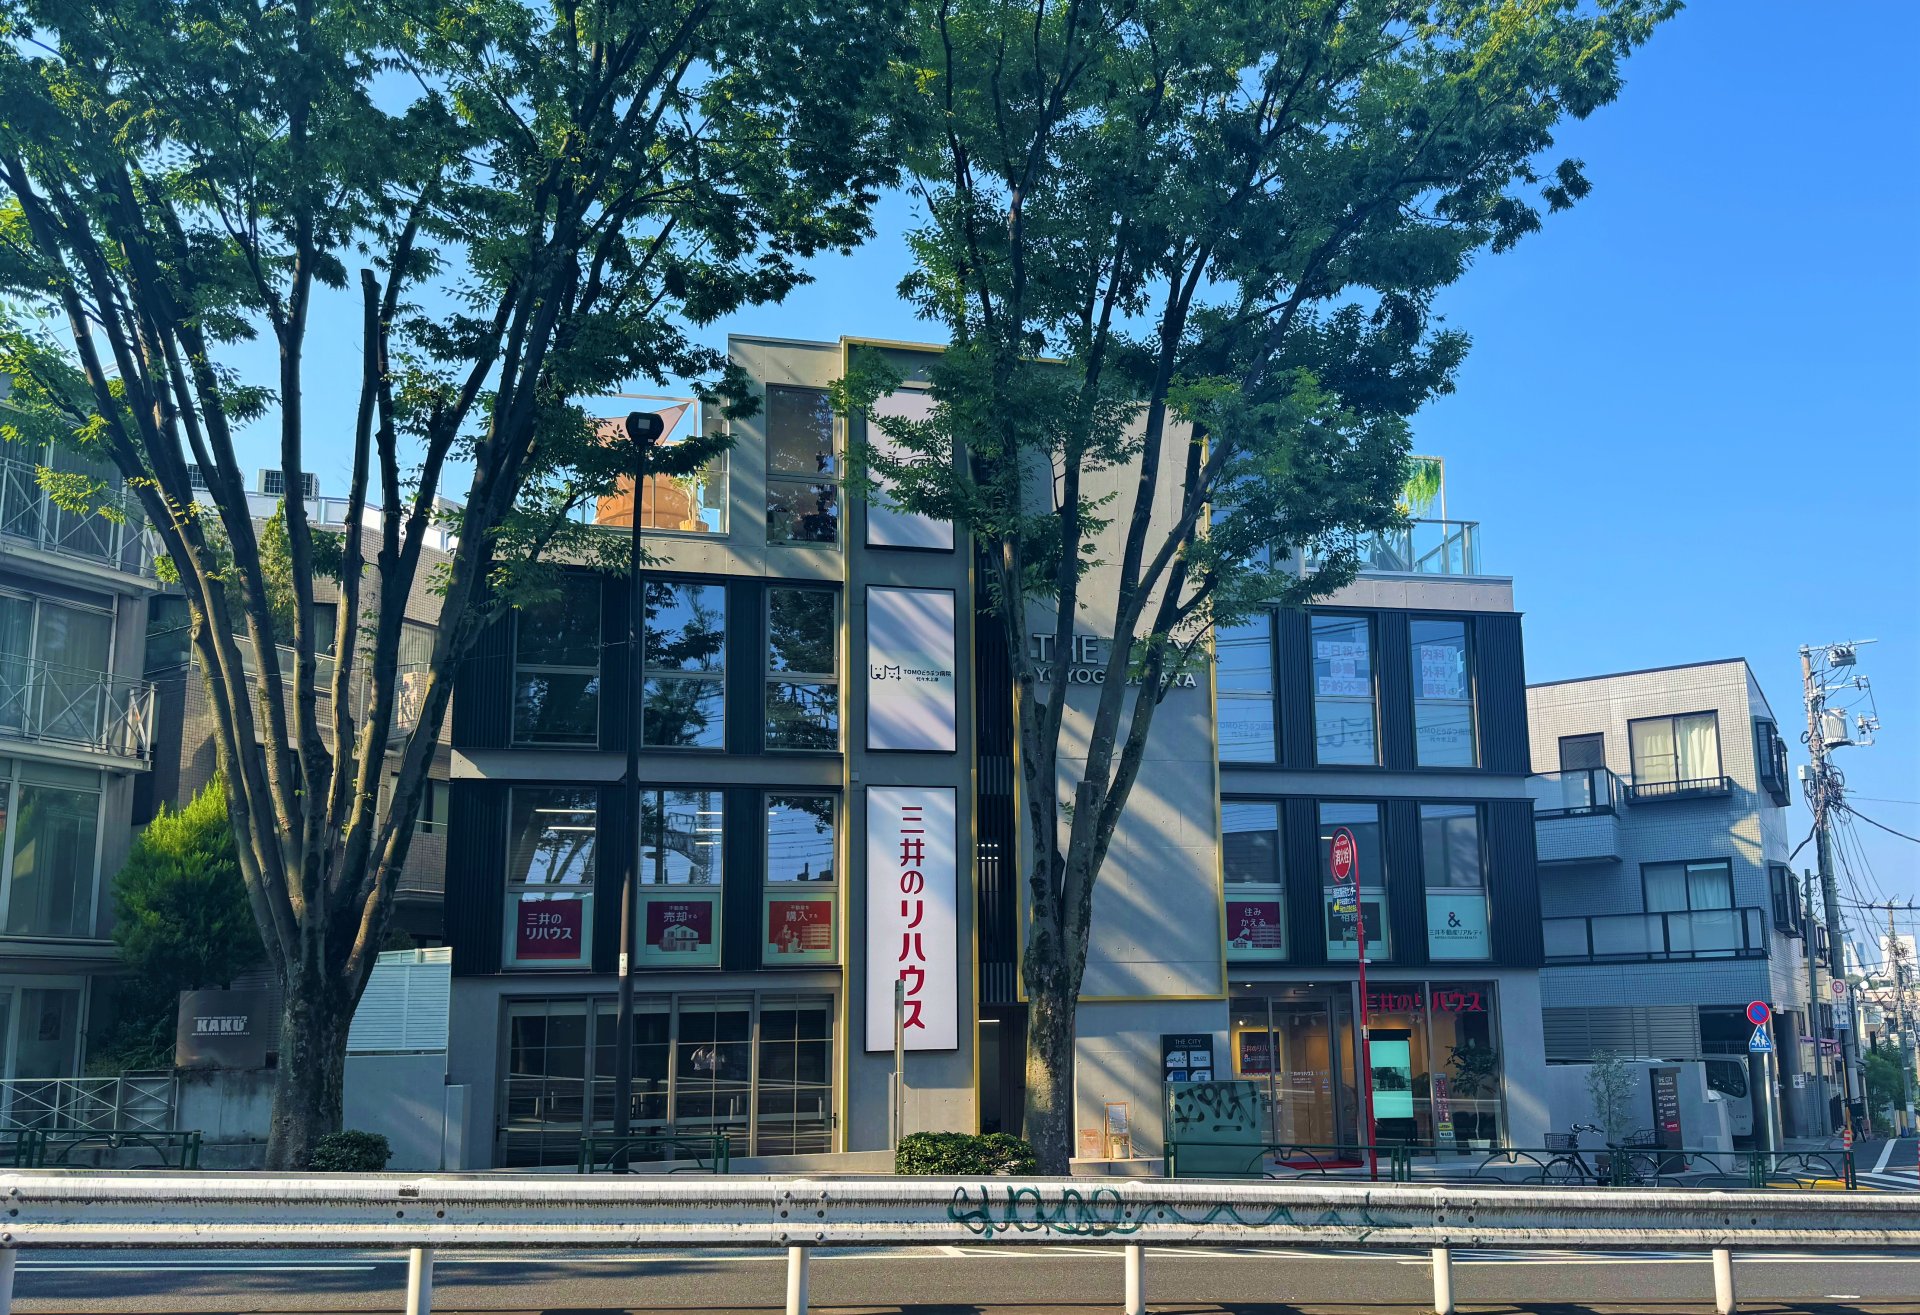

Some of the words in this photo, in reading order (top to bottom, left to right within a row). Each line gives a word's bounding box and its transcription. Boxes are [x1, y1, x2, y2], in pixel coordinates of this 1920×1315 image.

[1422, 648, 1445, 661] 内科
[1423, 666, 1446, 678] 外科
[526, 912, 562, 925] 三井の
[899, 806, 926, 1030] 三井のリハウス
[1244, 907, 1262, 917] 住み
[1240, 918, 1266, 927] かえる
[526, 927, 573, 940] リハウス
[1366, 991, 1483, 1013] 三井のリハウス
